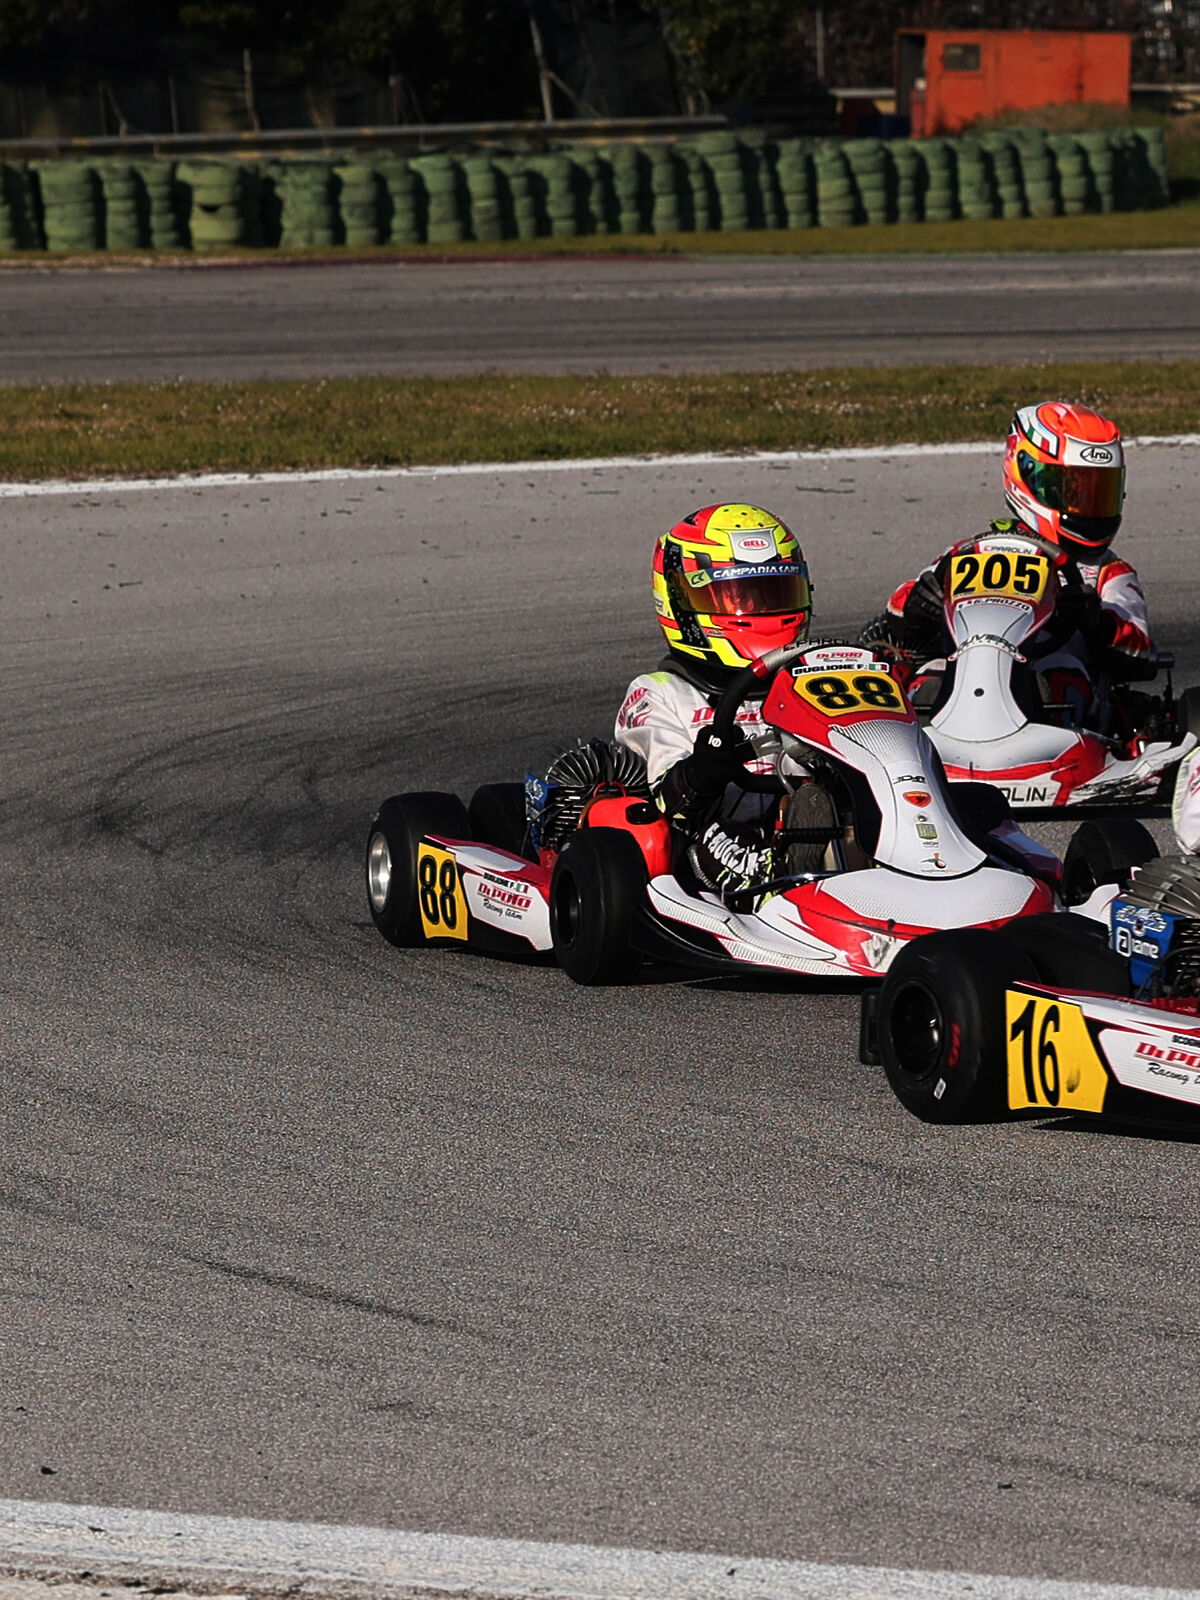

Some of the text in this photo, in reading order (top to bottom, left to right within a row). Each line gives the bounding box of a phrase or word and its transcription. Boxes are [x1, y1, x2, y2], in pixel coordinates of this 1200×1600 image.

[1084, 447, 1109, 459] Arai
[713, 566, 778, 578] CAMPANIA
[953, 554, 1041, 596] 205
[795, 664, 854, 676] BUGLIONE
[805, 676, 901, 709] 88
[420, 855, 457, 930] 88
[1010, 1000, 1060, 1107] 16
[1147, 1062, 1190, 1084] Racing
